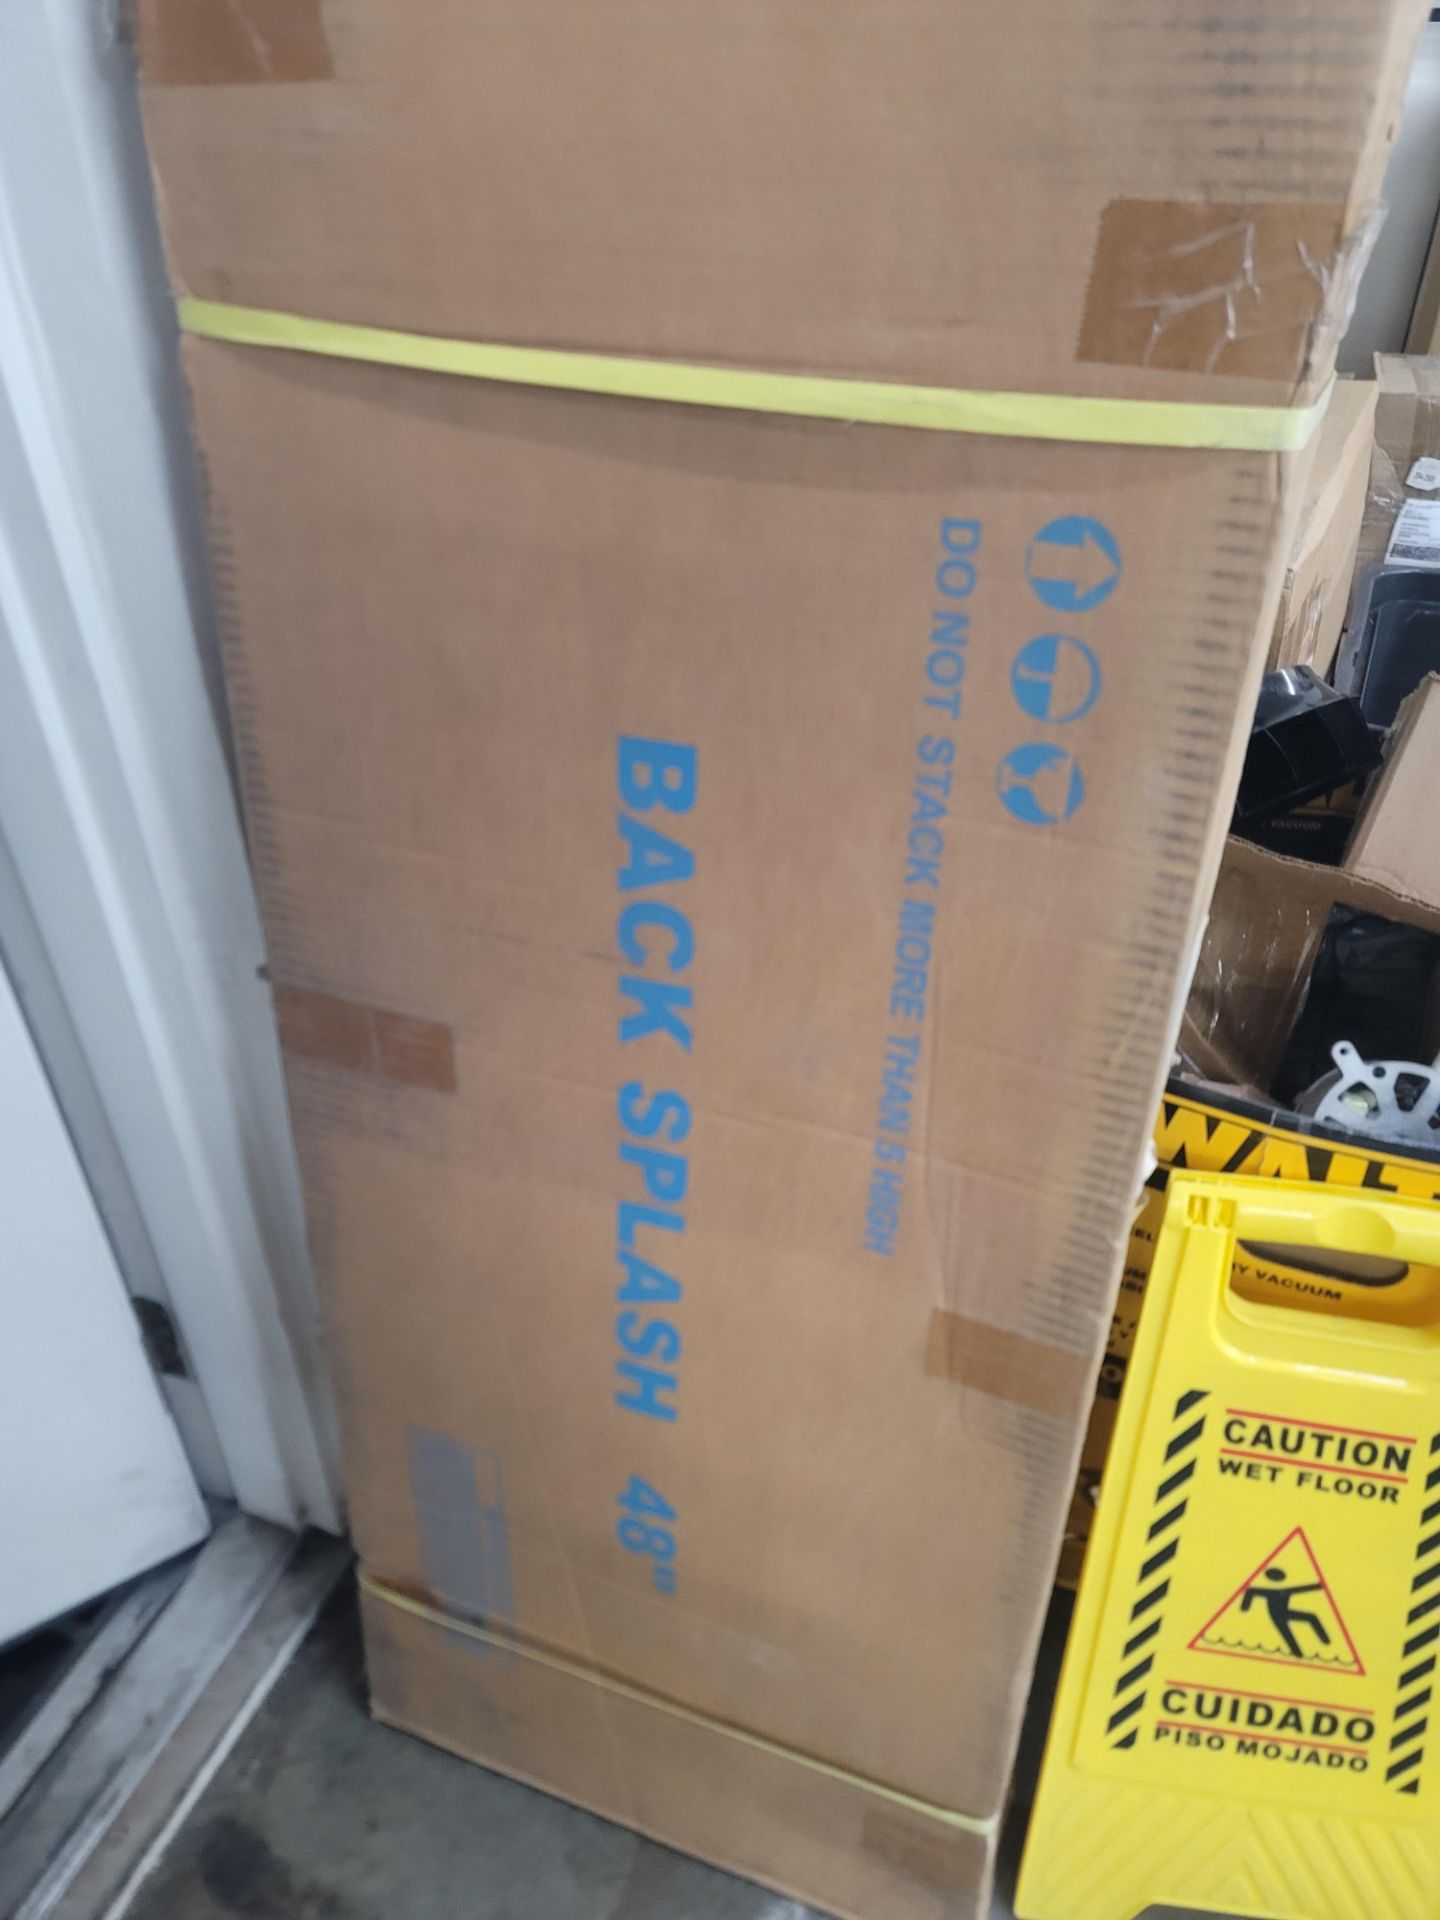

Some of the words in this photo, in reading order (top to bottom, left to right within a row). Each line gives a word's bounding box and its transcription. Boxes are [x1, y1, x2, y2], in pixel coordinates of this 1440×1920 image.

[935, 517, 983, 600] DO
[923, 608, 971, 721] NOT
[904, 735, 956, 891] STACK
[1271, 819, 1322, 831] VACUUM
[616, 733, 698, 1056] BACK
[889, 900, 936, 1022] MORE
[876, 1034, 922, 1135] THAN
[873, 1139, 907, 1165] 5
[615, 1080, 692, 1423] SPLASH
[863, 1169, 904, 1257] HIGH
[1256, 1269, 1342, 1301] VACUUM
[1218, 1458, 1283, 1483] WET
[1297, 1472, 1400, 1504] FLOOR
[1224, 1419, 1411, 1473] CAUTION
[616, 1473, 679, 1596] 48"
[1154, 1727, 1226, 1751] PISO
[1235, 1738, 1369, 1773] MOJADO
[1161, 1688, 1376, 1743] CUIDADO
